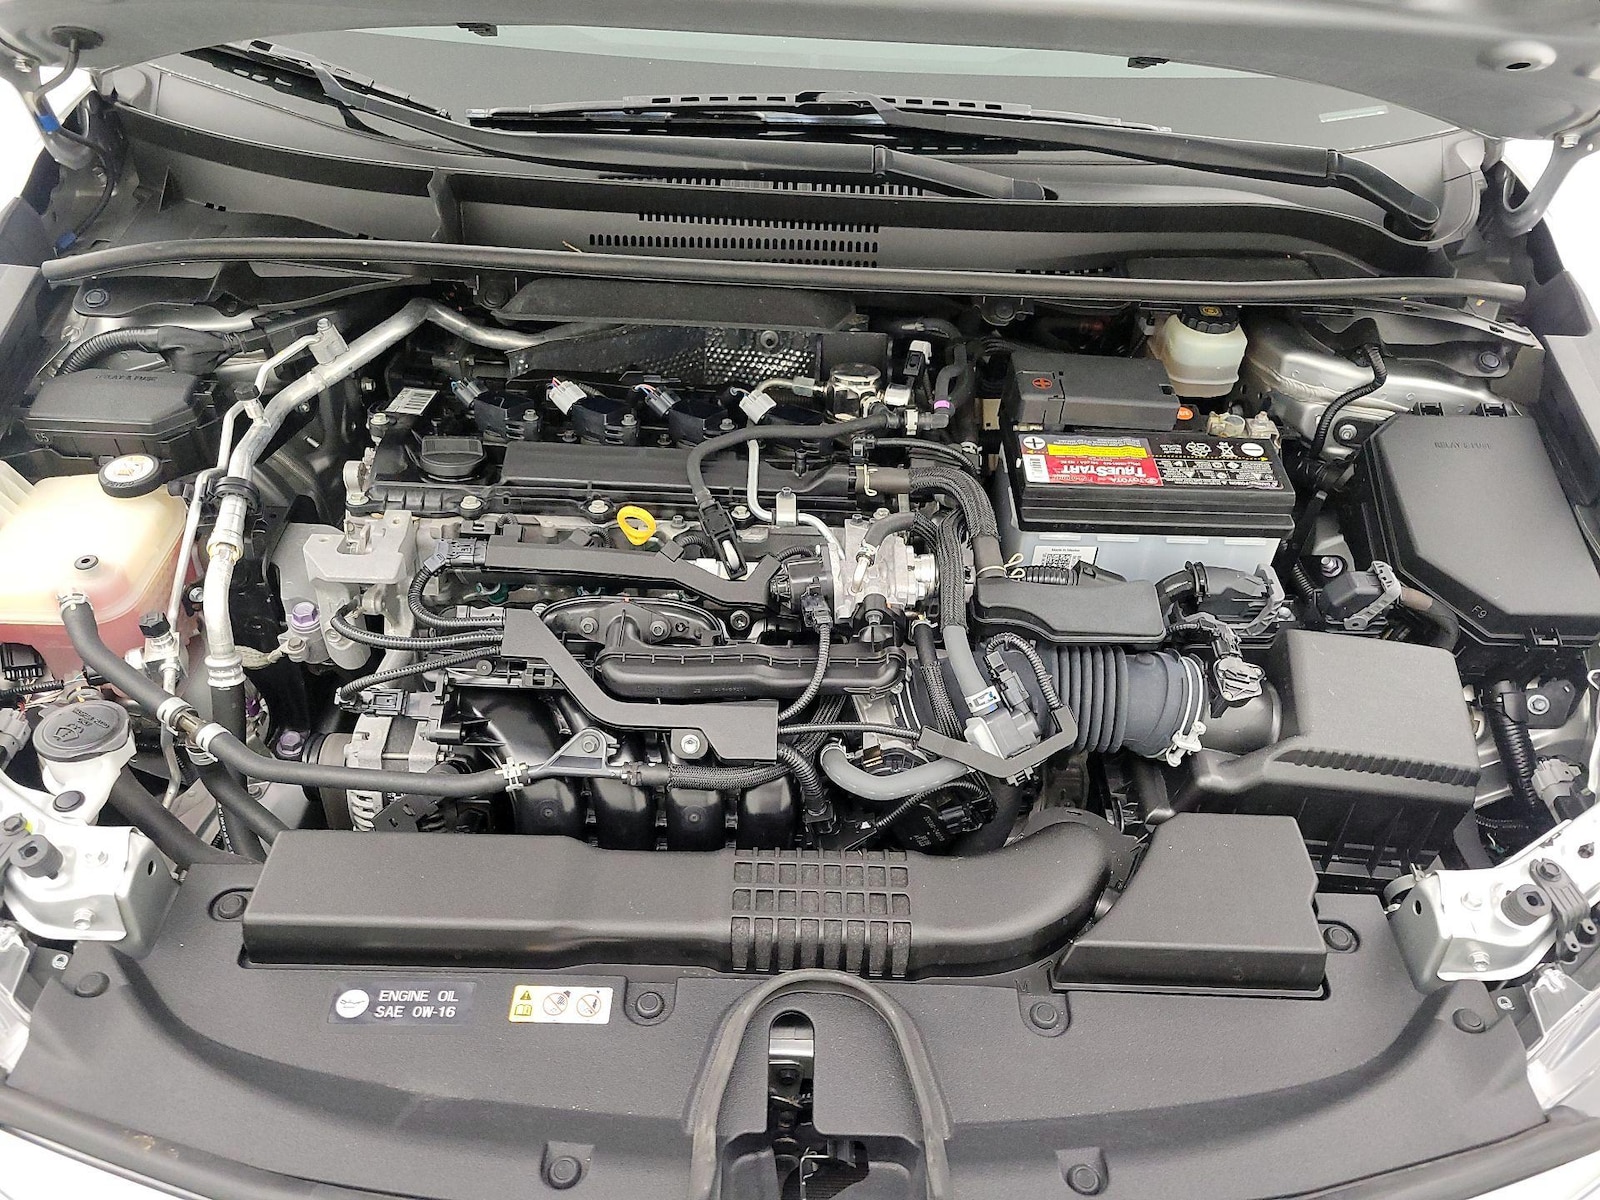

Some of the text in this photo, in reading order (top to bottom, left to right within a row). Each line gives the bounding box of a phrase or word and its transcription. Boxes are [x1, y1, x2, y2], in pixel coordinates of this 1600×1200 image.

[35, 432, 50, 443] C5
[1111, 475, 1148, 484] TOYOTA
[1471, 604, 1488, 619] F9
[379, 990, 459, 1002] ENGINE OIL
[374, 1006, 456, 1018] SAE 0W-16
